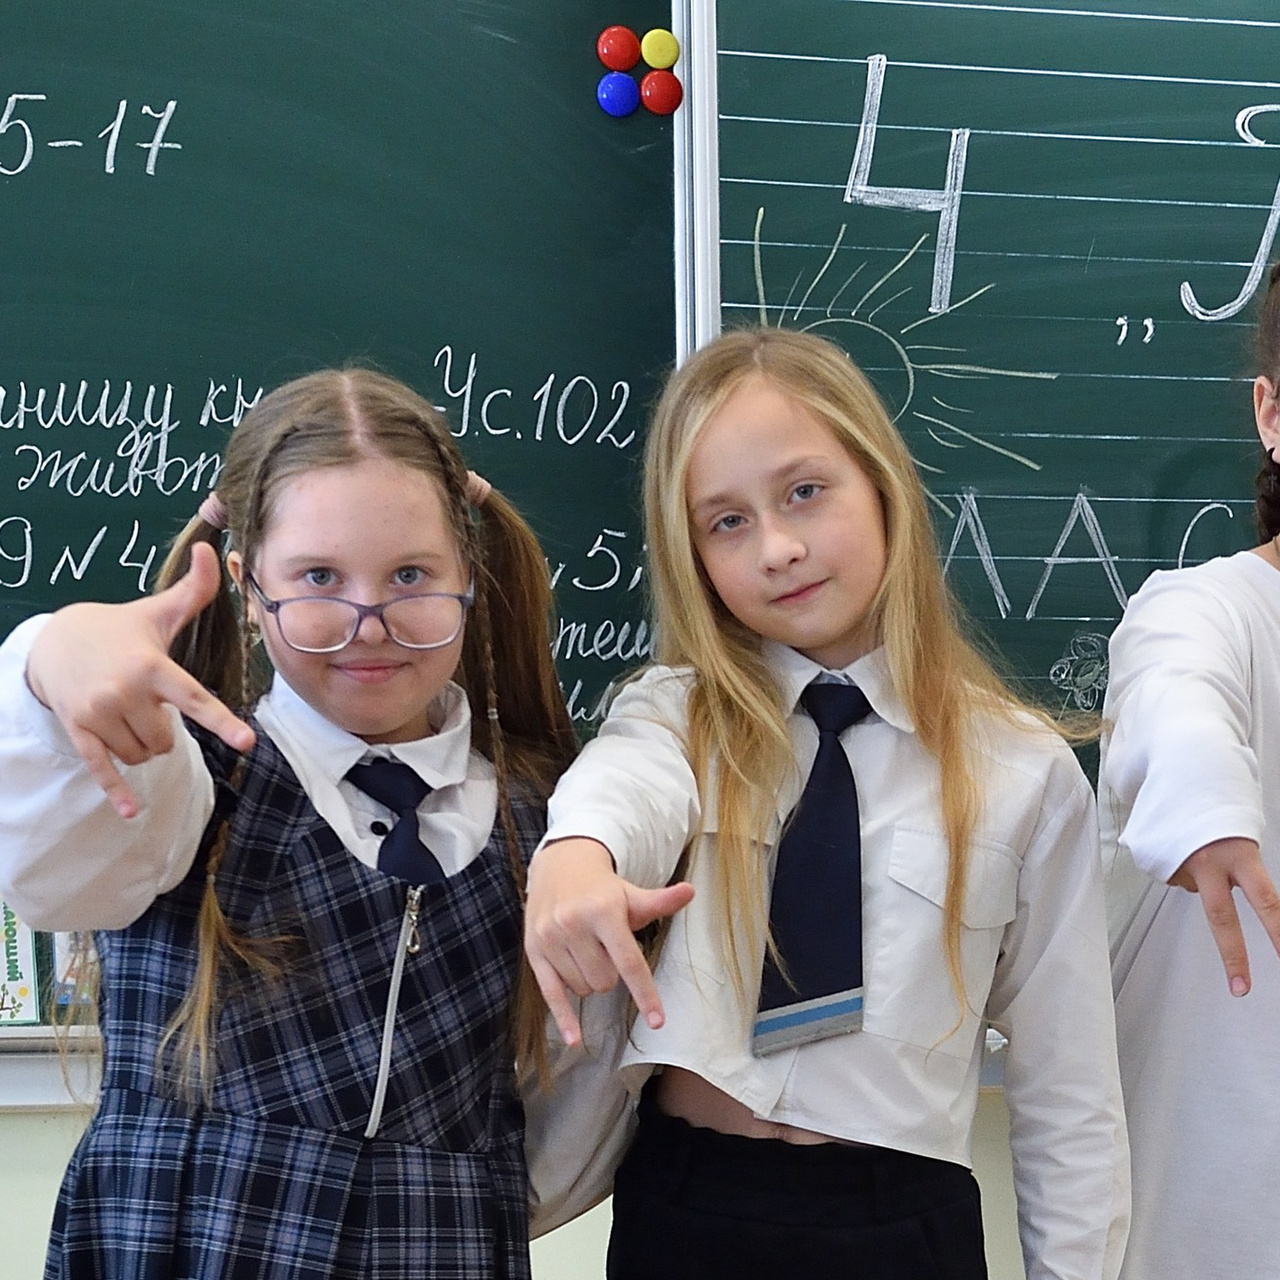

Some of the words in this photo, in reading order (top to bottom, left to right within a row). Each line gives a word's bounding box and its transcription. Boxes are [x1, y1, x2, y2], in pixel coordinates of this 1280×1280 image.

[845, 52, 971, 315] 4
[15, 431, 227, 497] живот
[118, 519, 157, 593] 4
[942, 484, 1235, 622] ЛАС
[2, 902, 24, 982] АЮЩИЙ
